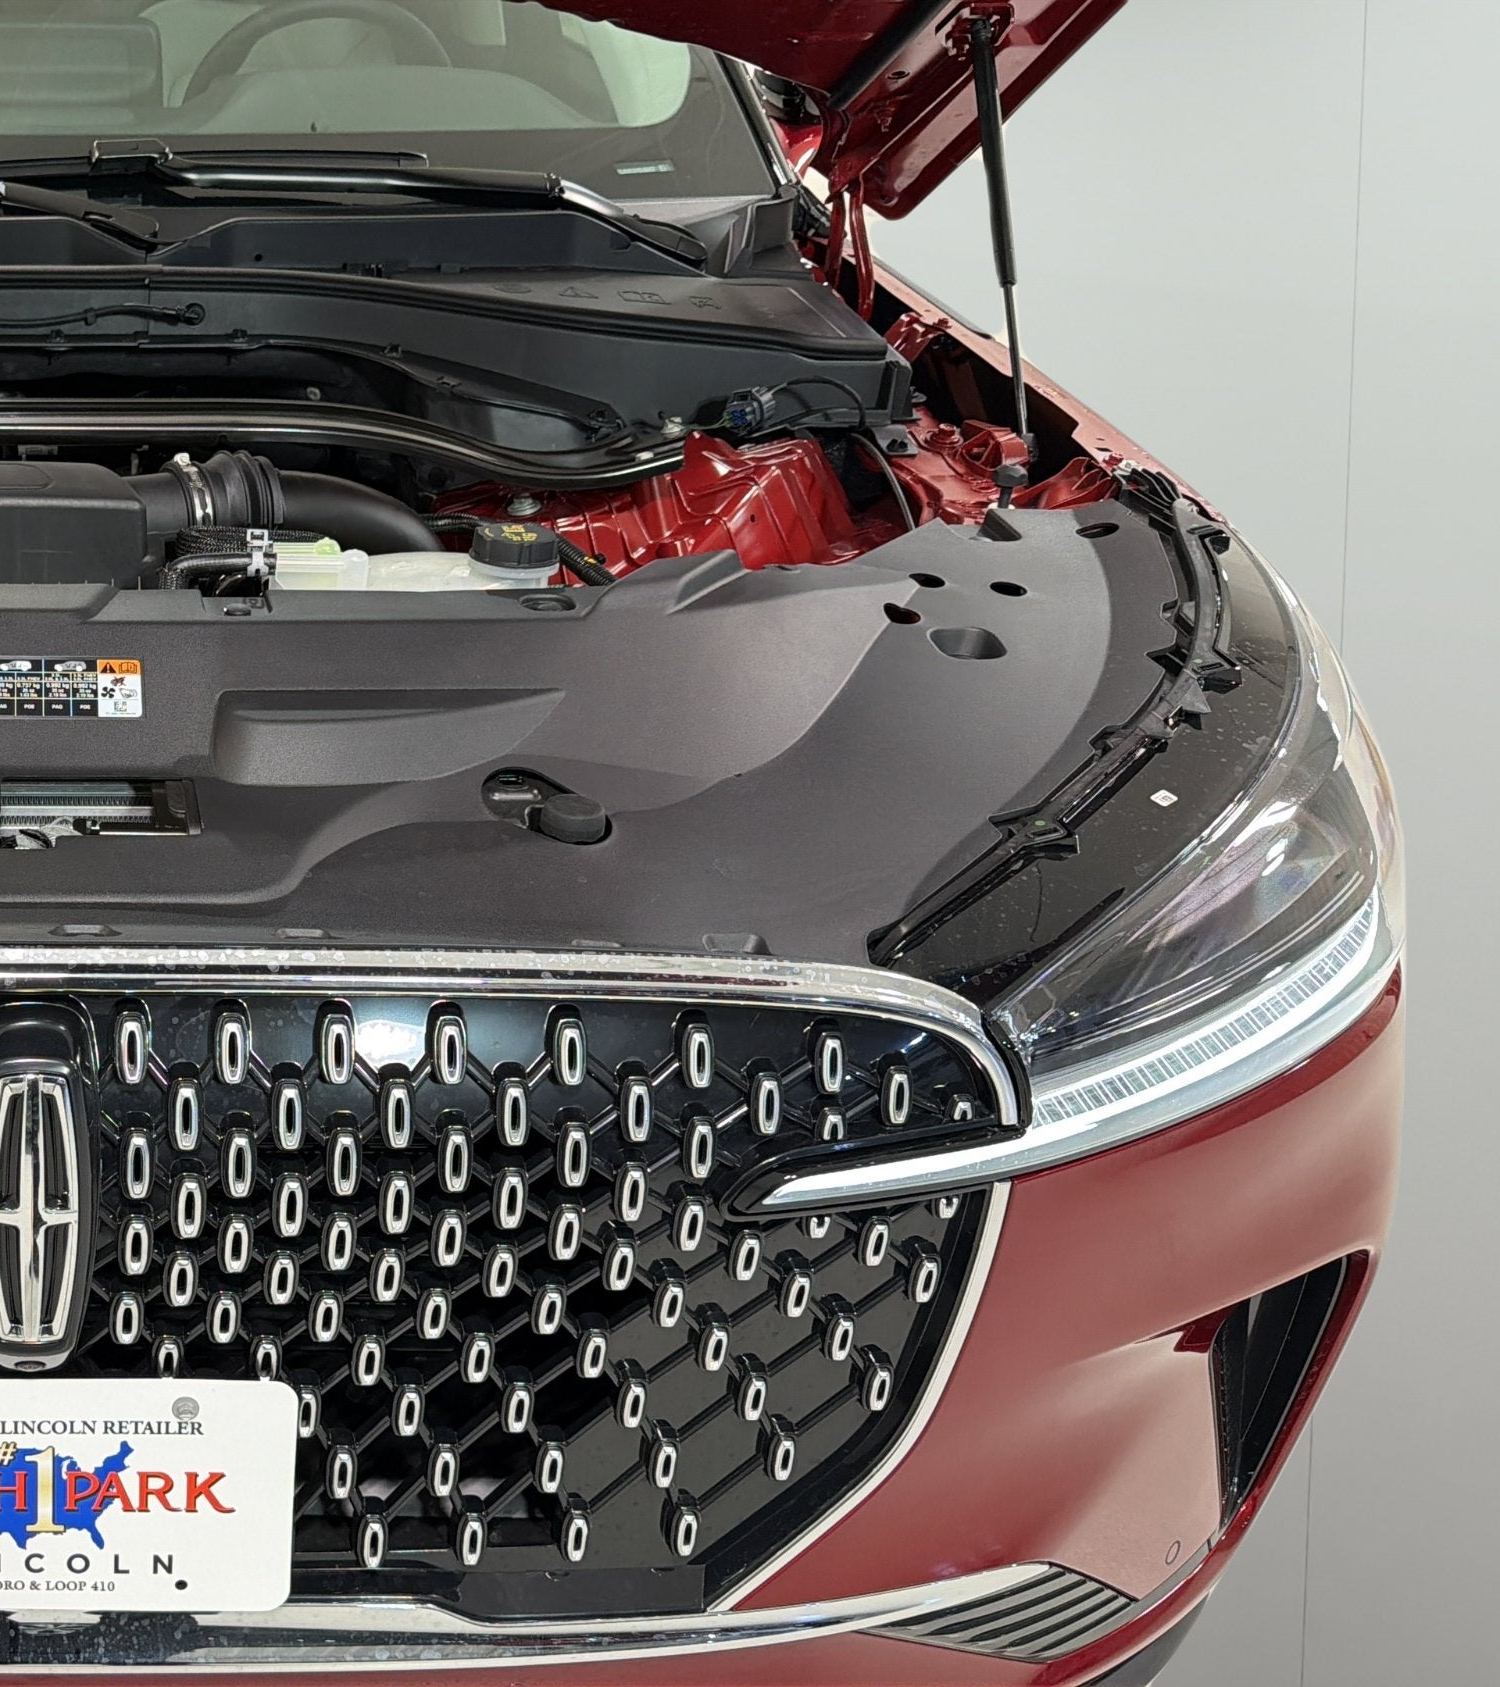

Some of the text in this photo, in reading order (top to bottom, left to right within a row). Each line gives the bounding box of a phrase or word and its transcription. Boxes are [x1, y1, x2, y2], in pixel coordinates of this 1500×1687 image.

[0, 1420, 98, 1436] LINCOLN
[102, 1420, 205, 1437] RETAILER
[64, 1471, 237, 1514] PARK
[29, 1580, 42, 1592] &
[45, 1580, 87, 1592] LOOP
[91, 1581, 116, 1592] 410
